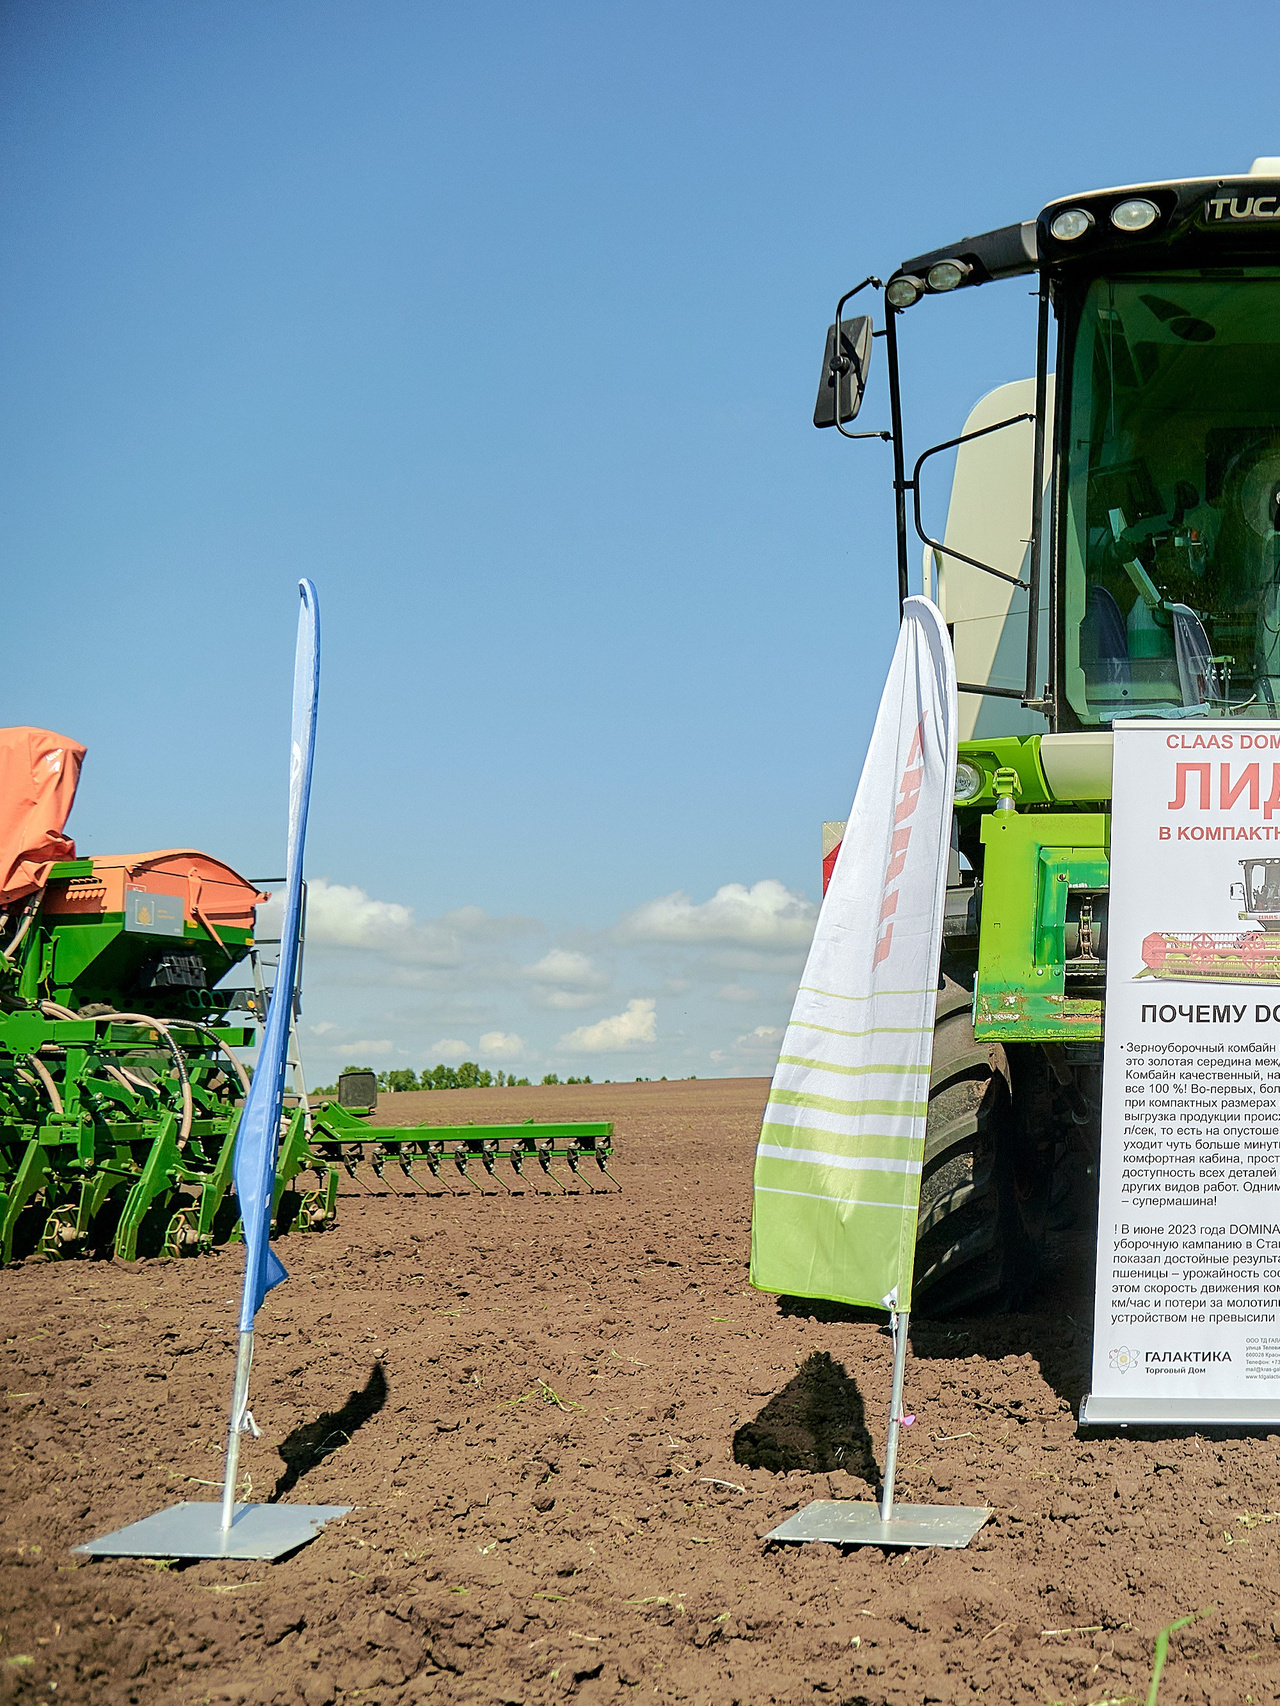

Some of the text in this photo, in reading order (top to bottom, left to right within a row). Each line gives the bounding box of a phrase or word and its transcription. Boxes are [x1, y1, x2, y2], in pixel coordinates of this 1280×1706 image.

[1166, 734, 1233, 750] CLAAS
[1159, 827, 1172, 840] В
[1141, 1005, 1246, 1023] ПОЧЕМУ
[1126, 1041, 1225, 1055] Зерноуборочный
[1227, 1042, 1276, 1053] комбайн
[1125, 1057, 1145, 1067] это
[1147, 1058, 1194, 1067] золотая
[1196, 1058, 1252, 1069] середина
[1125, 1069, 1176, 1080] Комбайн
[1179, 1069, 1264, 1082] качественный,
[1125, 1085, 1145, 1094] все
[1149, 1083, 1170, 1094] 100
[1172, 1083, 1187, 1094] %!
[1191, 1083, 1256, 1096] Во-первых,
[1124, 1099, 1146, 1110] при
[1148, 1099, 1218, 1108] компактных
[1221, 1099, 1277, 1110] размерах
[1124, 1112, 1176, 1124] выгрузка
[1179, 1113, 1241, 1124] продукции
[1123, 1124, 1157, 1137] л/сек,
[1160, 1127, 1174, 1136] то
[1176, 1127, 1203, 1136] есть
[1205, 1127, 1220, 1136] на
[1123, 1140, 1164, 1152] уходит
[1166, 1141, 1192, 1152] чуть
[1195, 1138, 1241, 1150] больше
[1123, 1152, 1196, 1166] комфортная
[1199, 1152, 1244, 1165] кабина,
[1121, 1168, 1196, 1180] доступность
[1199, 1169, 1226, 1178] всех
[1227, 1166, 1277, 1180] деталей
[1121, 1183, 1162, 1194] других
[1164, 1183, 1200, 1194] видов
[1203, 1181, 1239, 1194] работ.
[1132, 1195, 1217, 1209] супермашина!
[1121, 1223, 1130, 1235] В
[1133, 1226, 1165, 1235] июне
[1167, 1223, 1197, 1235] 2023
[1200, 1226, 1226, 1237] года
[1113, 1238, 1179, 1252] уборочную
[1182, 1240, 1243, 1250] кампанию
[1245, 1240, 1253, 1250] в
[1113, 1255, 1161, 1264] показал
[1163, 1253, 1230, 1266] достойные
[1112, 1269, 1168, 1280] пшеницы
[1182, 1267, 1260, 1281] урожайность
[1111, 1284, 1141, 1293] этом
[1143, 1284, 1198, 1296] скорость
[1199, 1284, 1260, 1295] движения
[1111, 1296, 1151, 1308] км/час
[1154, 1299, 1161, 1308] и
[1164, 1299, 1207, 1311] потери
[1209, 1299, 1223, 1308] за
[1110, 1311, 1187, 1326] устройством
[1191, 1314, 1206, 1323] не
[1209, 1313, 1276, 1325] превысили
[1145, 1351, 1232, 1363] ГАЛАКТИКА
[1145, 1366, 1206, 1375] Торговый Дом
